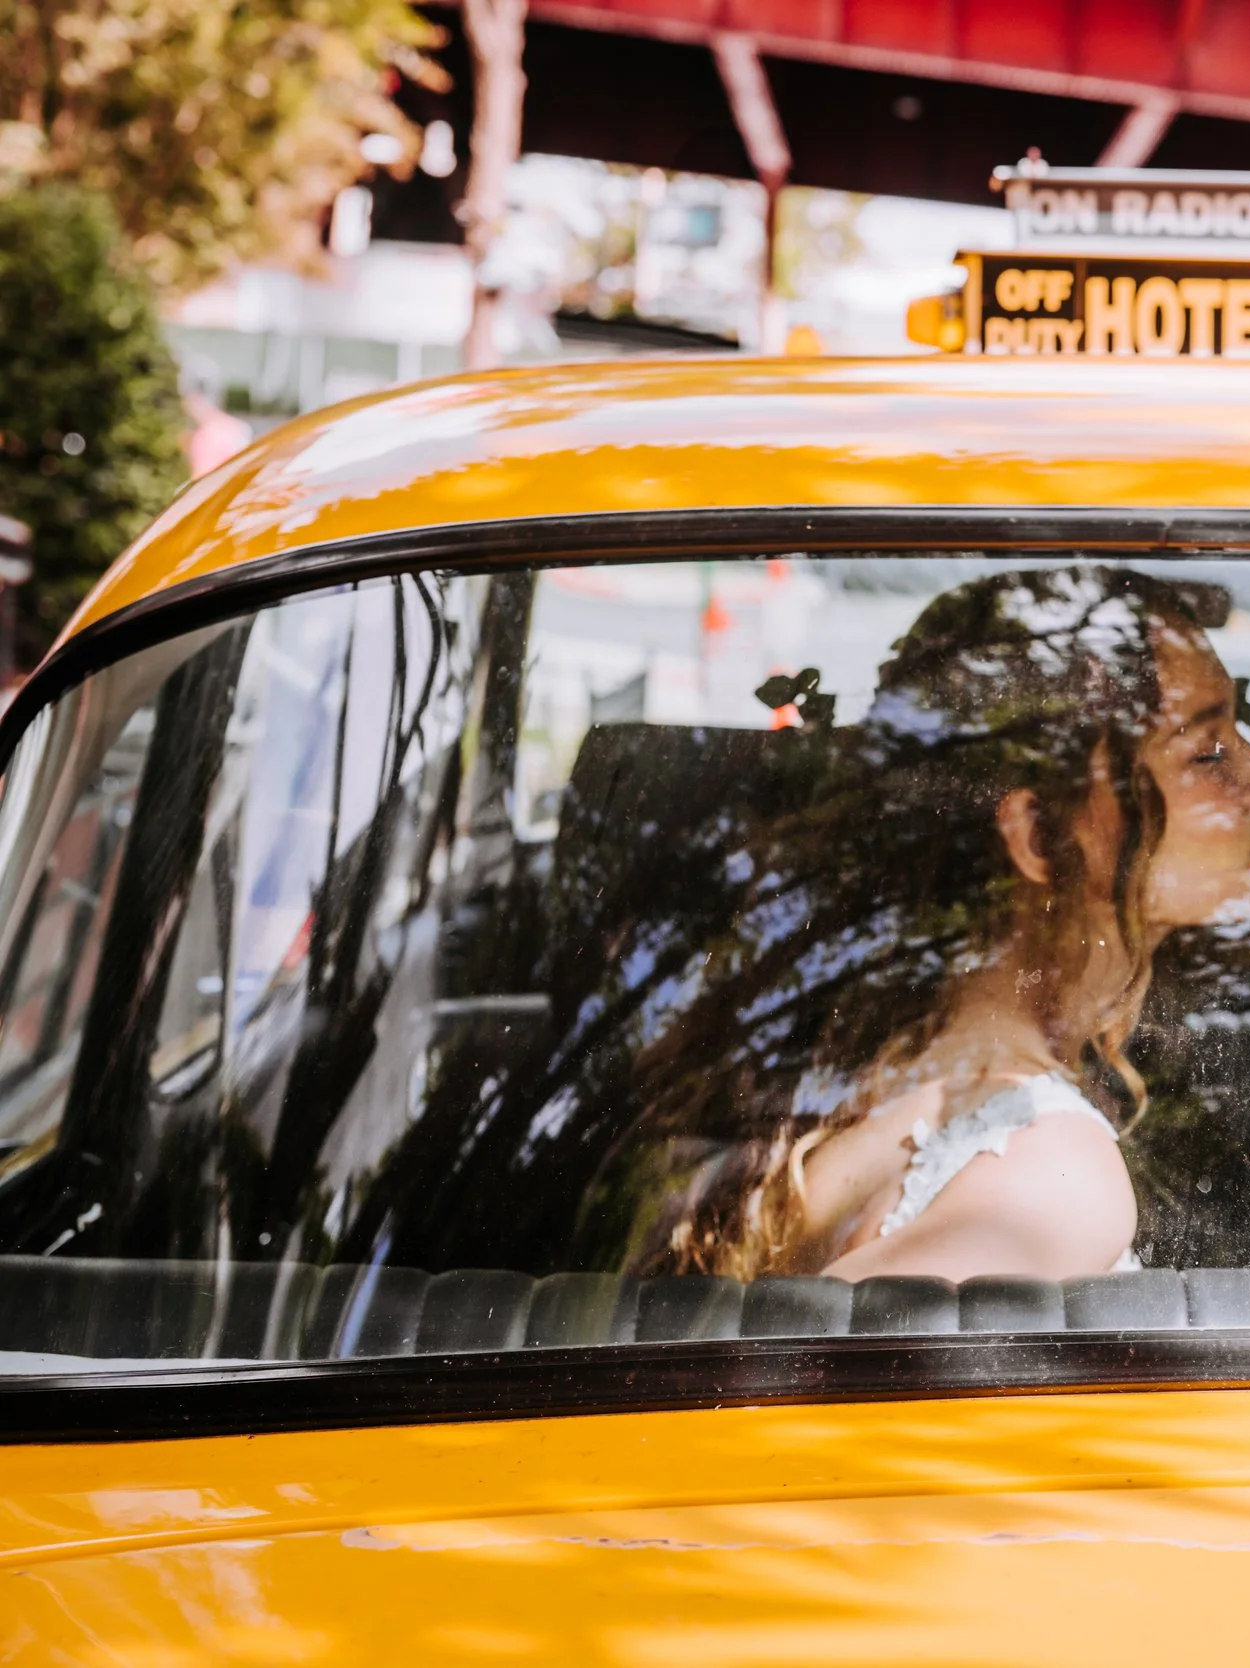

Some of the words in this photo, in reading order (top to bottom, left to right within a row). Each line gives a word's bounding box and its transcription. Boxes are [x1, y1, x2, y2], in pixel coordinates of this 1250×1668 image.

[1031, 188, 1098, 234] ON
[995, 268, 1074, 312] OFF
[985, 317, 1083, 356] DUTY
